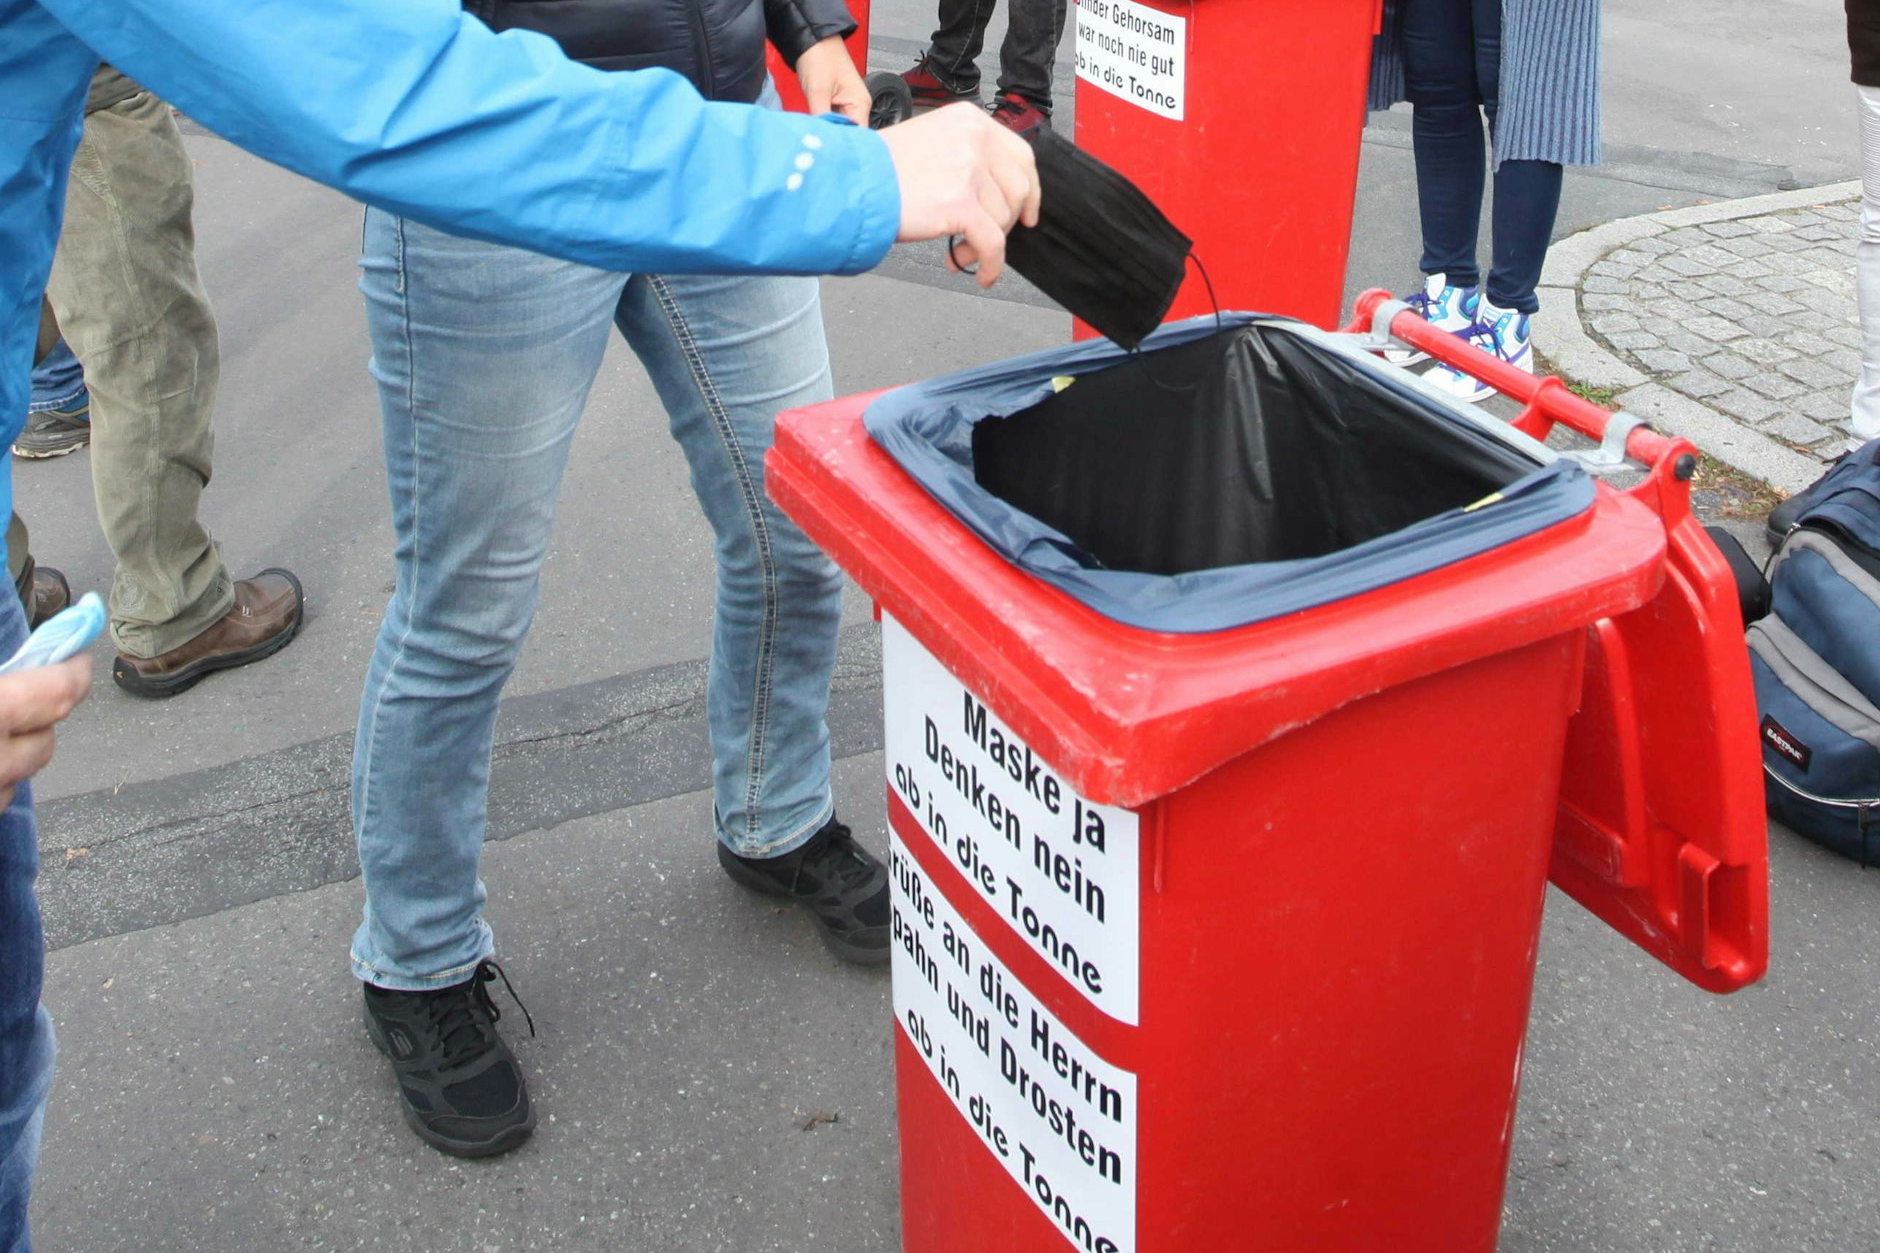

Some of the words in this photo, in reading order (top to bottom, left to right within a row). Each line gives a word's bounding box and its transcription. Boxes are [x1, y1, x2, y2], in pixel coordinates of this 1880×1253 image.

[1078, 21, 1095, 43] war
[1098, 31, 1124, 57] noch
[1128, 44, 1146, 66] nie
[1151, 55, 1174, 76] gut
[1089, 57, 1100, 77] in
[1103, 67, 1123, 88] die
[1128, 75, 1176, 109] Tonne
[1112, 4, 1175, 45] Gehorsam
[925, 713, 1021, 851] Denken
[1034, 833, 1105, 924] nein
[964, 689, 1061, 815] Maske
[1767, 728, 1802, 759] EASTPAK
[896, 762, 921, 810] ab
[928, 791, 948, 846] in
[957, 833, 996, 896] die
[1006, 875, 1102, 995] Tonne
[888, 850, 934, 930] rüße
[943, 920, 970, 976] an
[980, 960, 1019, 1030] die
[1031, 1006, 1123, 1124] Herrn
[893, 904, 939, 994] pahn
[947, 981, 989, 1059] und
[1001, 1035, 1122, 1185] Drosten
[907, 1009, 933, 1059] ab
[940, 1044, 960, 1101] in
[969, 1093, 1009, 1158] die
[1019, 1140, 1120, 1253] Tonne
